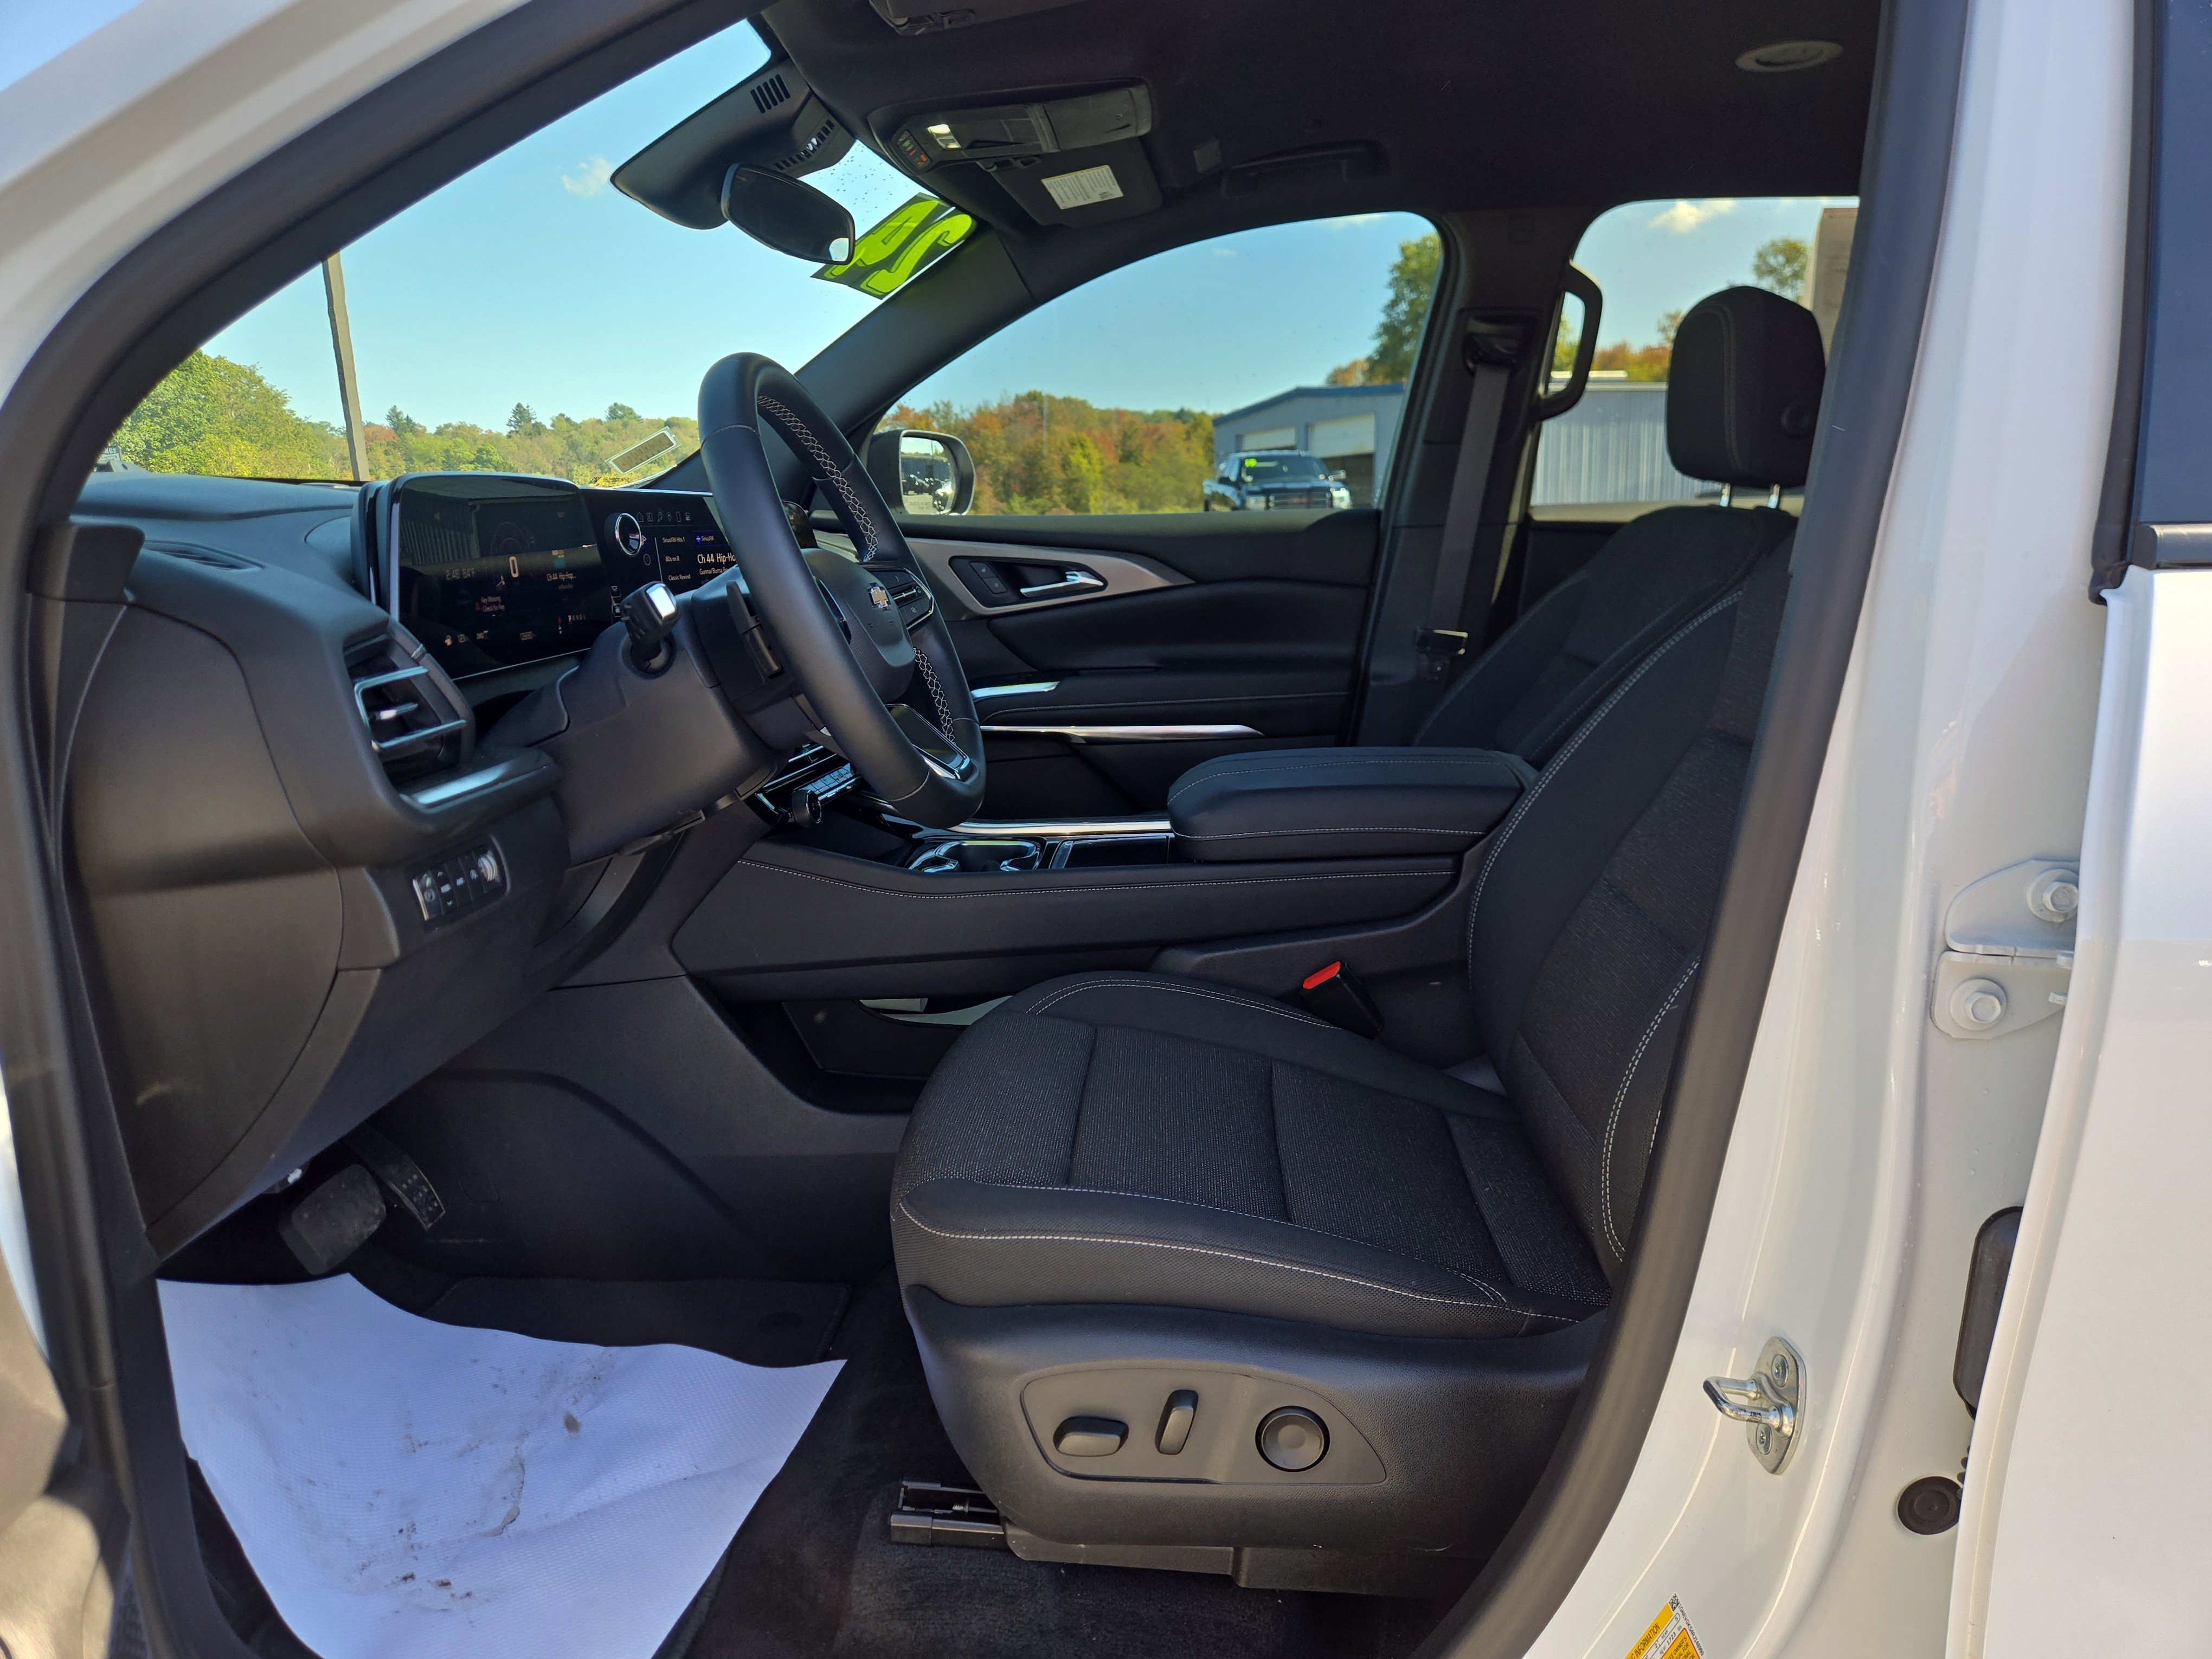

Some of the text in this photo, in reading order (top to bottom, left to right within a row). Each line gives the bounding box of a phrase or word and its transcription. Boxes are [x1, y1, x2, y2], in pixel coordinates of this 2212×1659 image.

[509, 556, 519, 577] 0
[697, 552, 736, 564] Ch 44 Hip-Ho
[1634, 1622, 1661, 1658] INFORMATION
[1667, 1632, 1676, 1645] 1723
